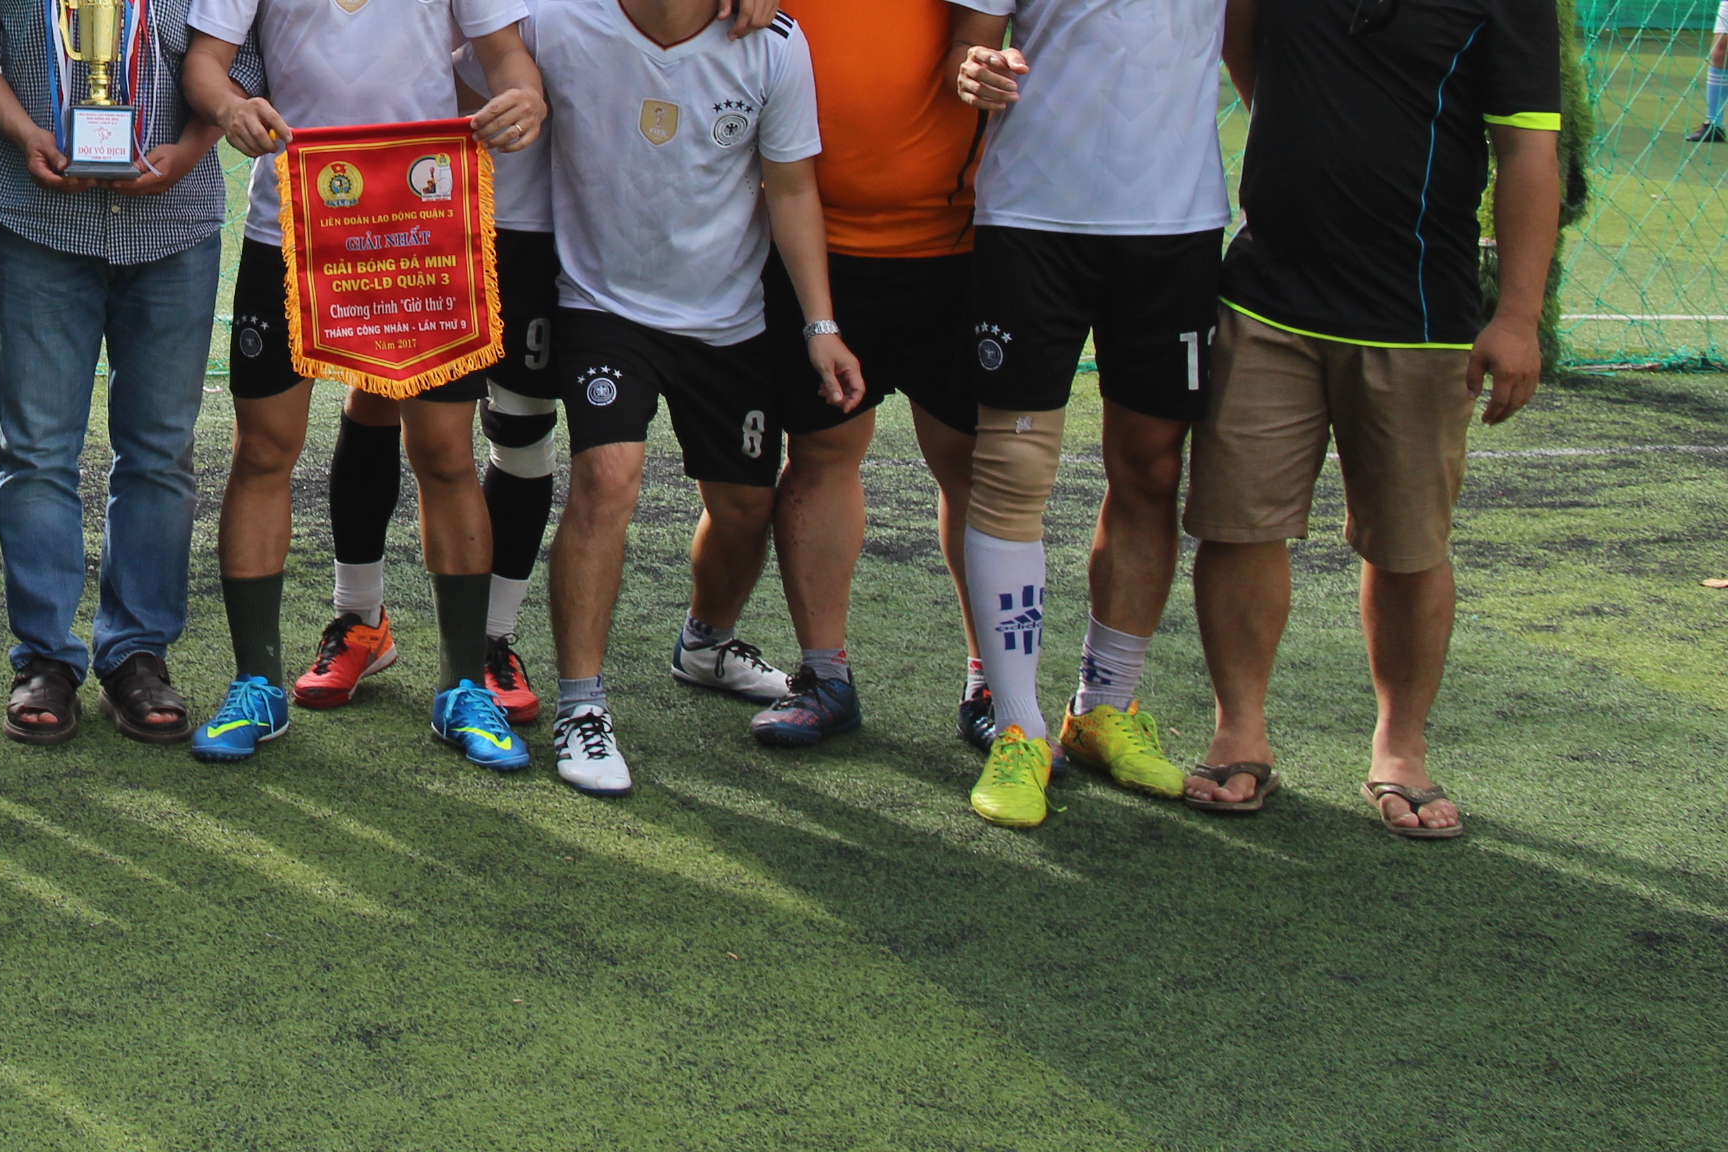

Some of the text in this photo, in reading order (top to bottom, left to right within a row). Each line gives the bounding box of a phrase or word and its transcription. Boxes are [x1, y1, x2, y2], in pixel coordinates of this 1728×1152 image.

[320, 216, 341, 227] LIÊN
[372, 214, 389, 224] LAO
[419, 208, 445, 221] QUẬN
[447, 209, 454, 218] 3
[345, 225, 431, 251] GIẢI NHẤT
[323, 254, 457, 276] GIẢI BÓNG ĐÁ MINI
[332, 271, 450, 292] CNVC-LĐ QUẬN 3
[330, 304, 371, 320] Chương
[373, 300, 398, 315] trình
[425, 295, 444, 311] thứ
[324, 326, 354, 339] THÁNG
[356, 324, 381, 336] CÔNG
[384, 321, 409, 334] NHÂN
[460, 320, 467, 329] 9
[374, 338, 417, 351] Năm 2017
[525, 318, 551, 370] 9
